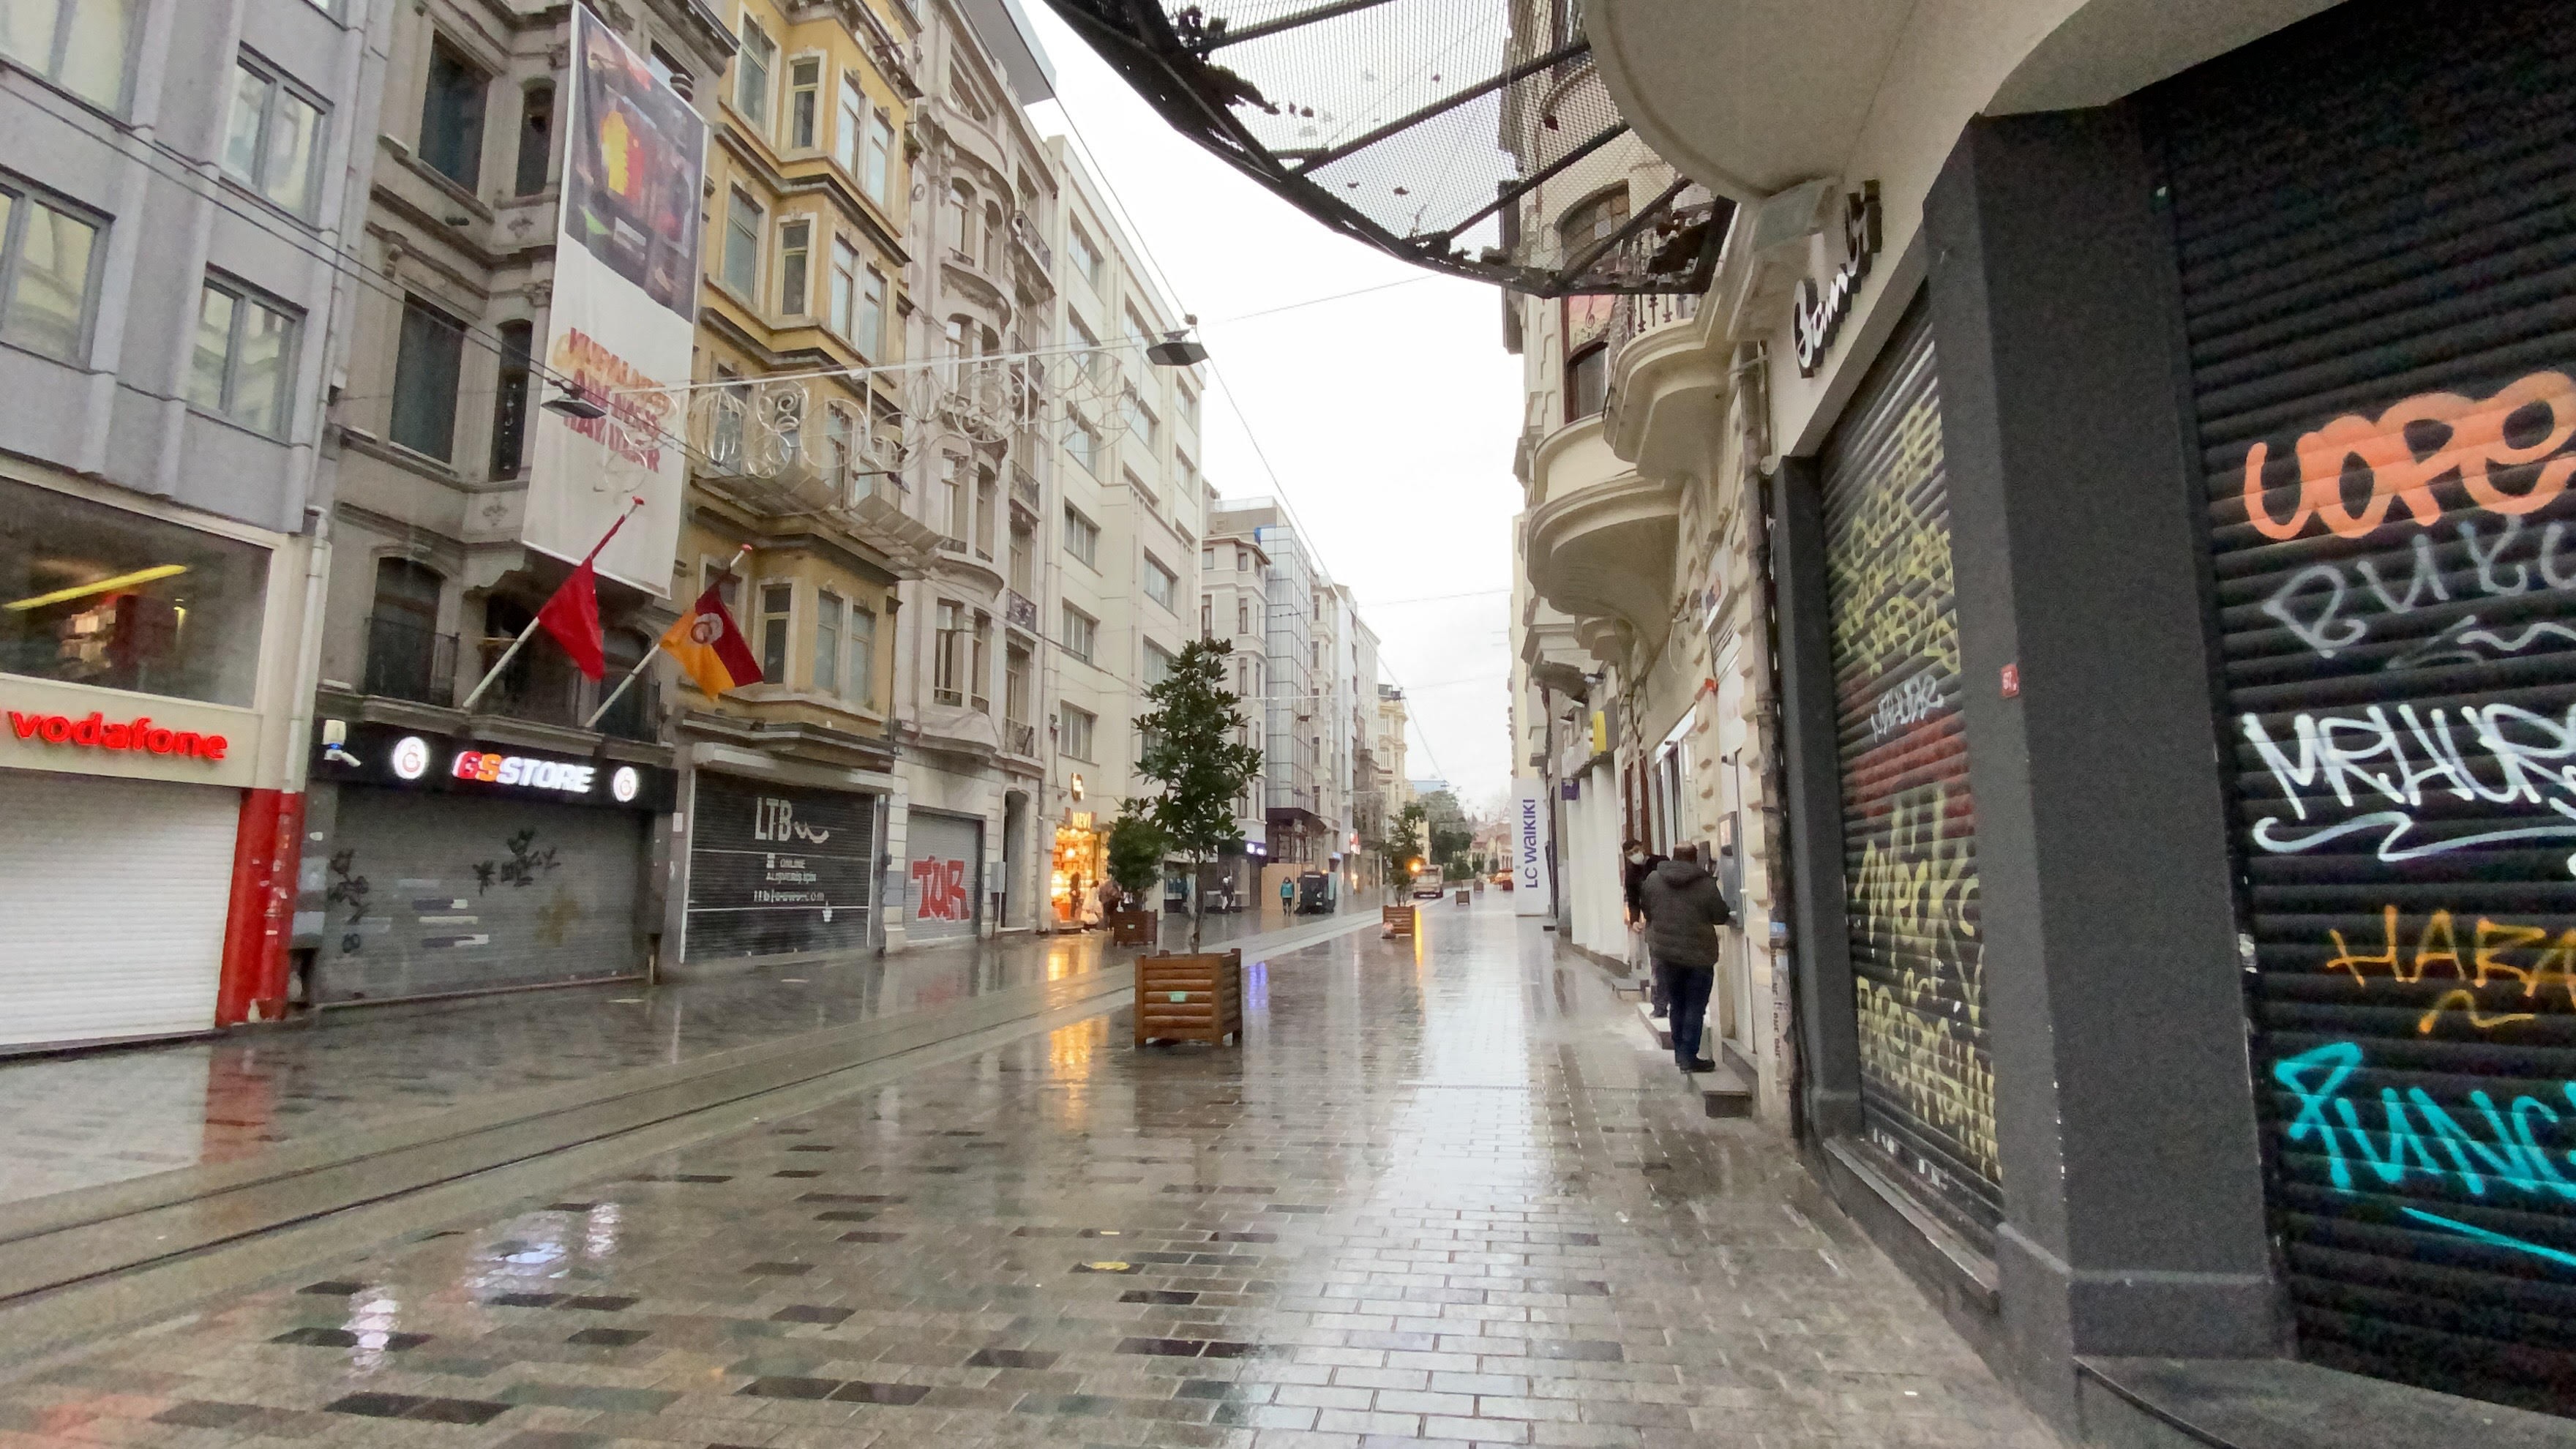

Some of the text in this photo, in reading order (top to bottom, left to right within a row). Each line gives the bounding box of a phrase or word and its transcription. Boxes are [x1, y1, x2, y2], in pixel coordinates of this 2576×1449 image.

[8, 711, 228, 762] vodafone
[755, 796, 793, 842] LTB
[1524, 866, 1538, 888] LC
